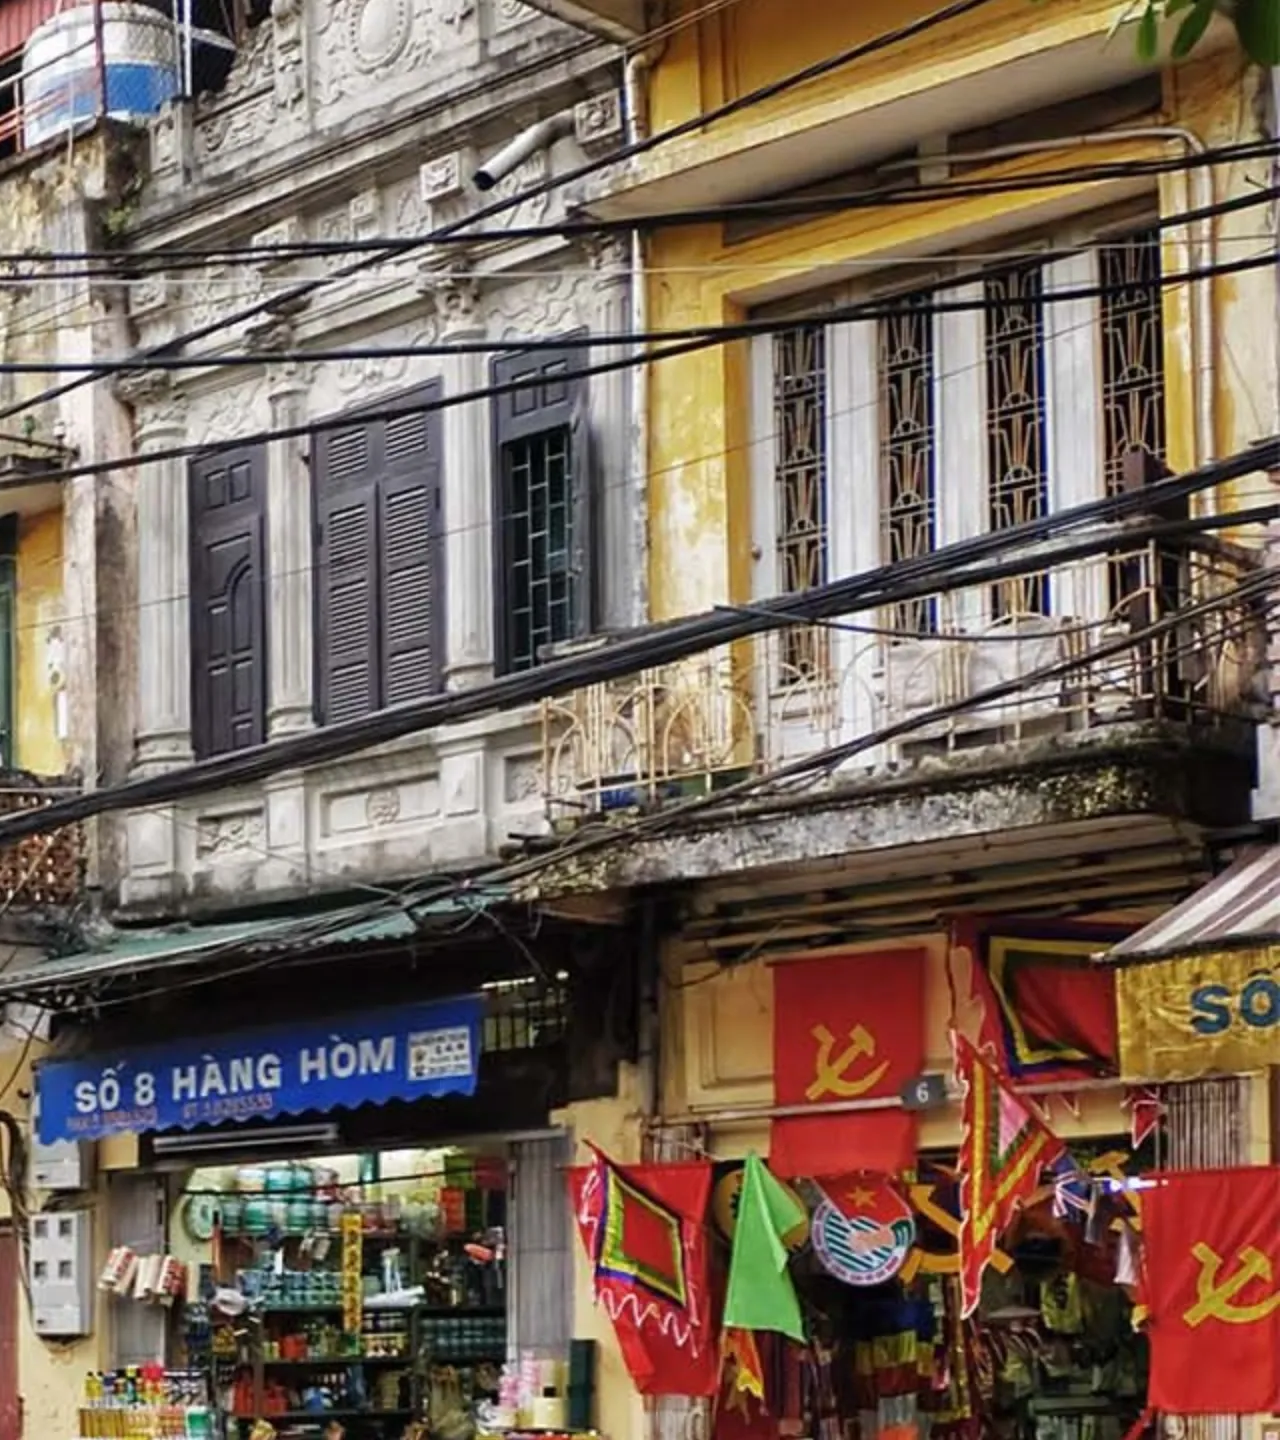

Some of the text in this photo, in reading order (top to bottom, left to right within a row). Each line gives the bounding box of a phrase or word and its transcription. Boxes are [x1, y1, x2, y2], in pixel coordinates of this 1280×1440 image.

[73, 1060, 127, 1114] SỐ
[134, 1071, 157, 1106] 8
[171, 1052, 283, 1101] HÀNG
[299, 1033, 397, 1085] HÒM
[915, 1080, 929, 1104] 6
